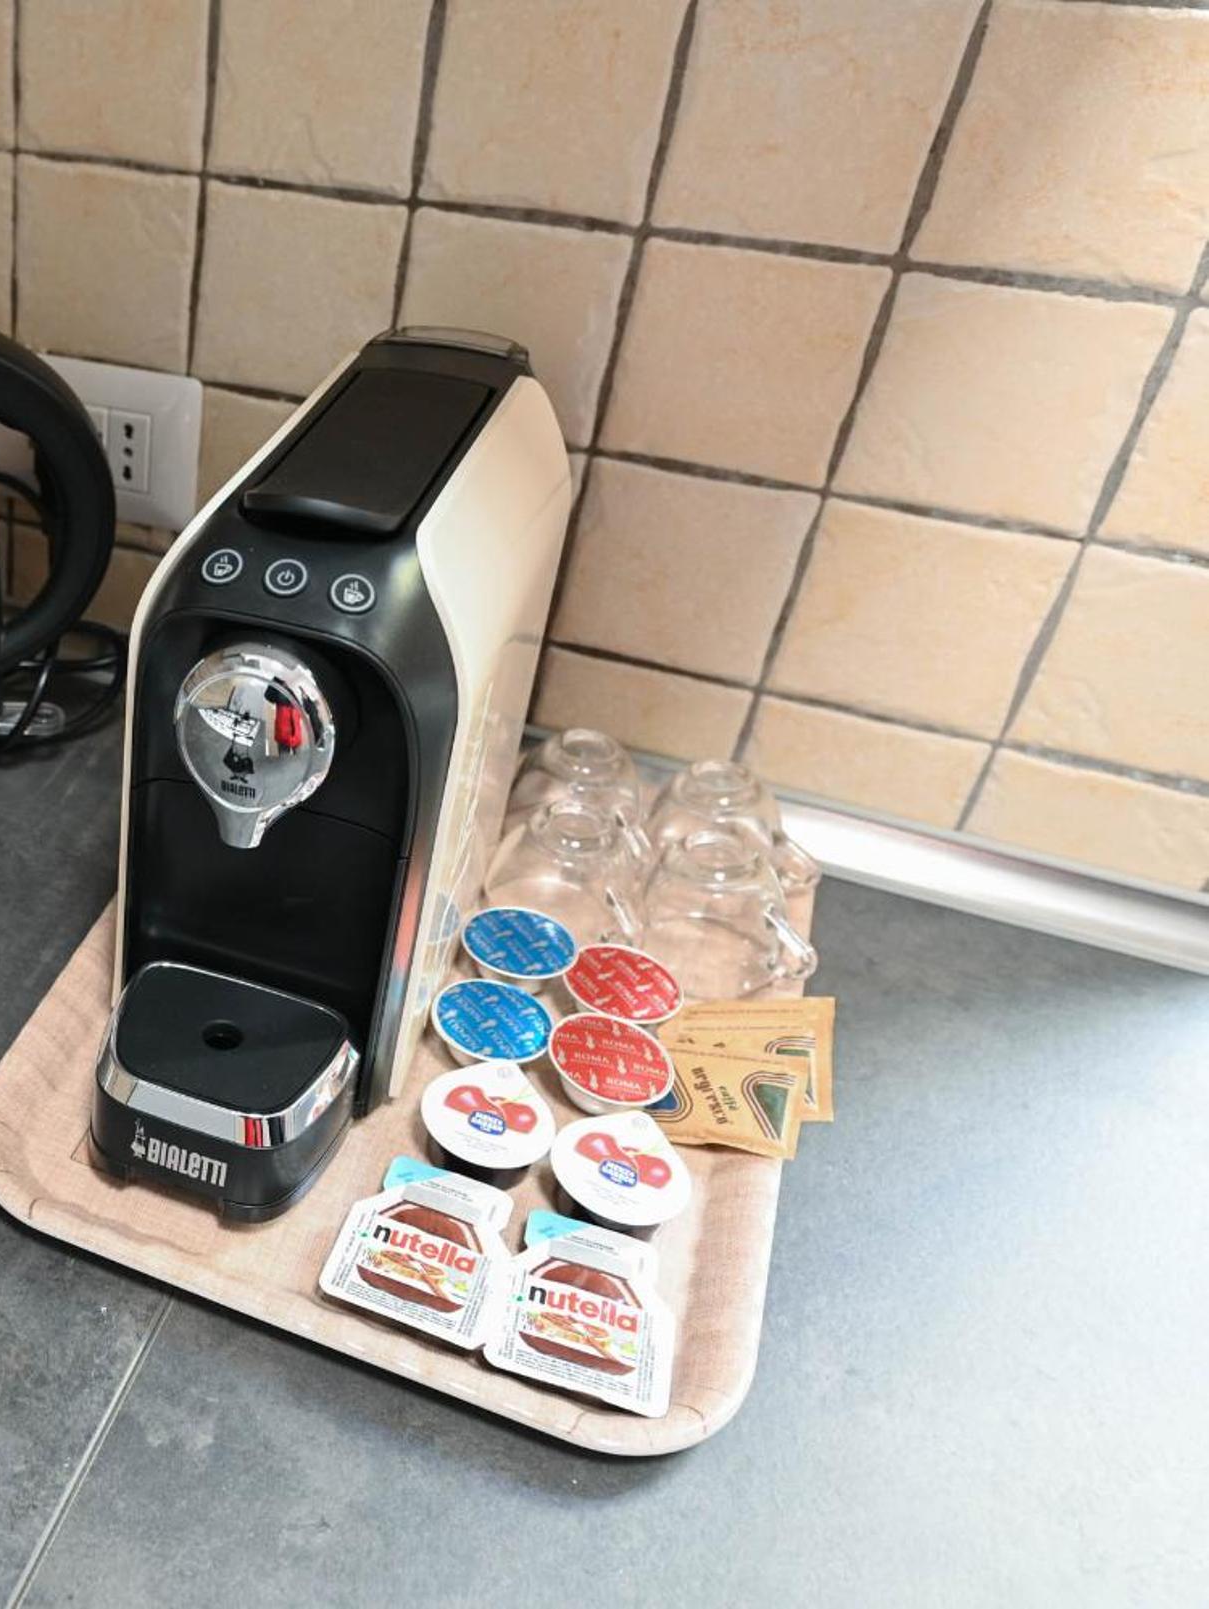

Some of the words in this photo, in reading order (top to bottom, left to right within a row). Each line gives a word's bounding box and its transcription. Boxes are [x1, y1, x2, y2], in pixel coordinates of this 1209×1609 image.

[146, 1137, 228, 1188] BIALETTI
[373, 1220, 477, 1276] nutella
[529, 1283, 639, 1333] nutella
